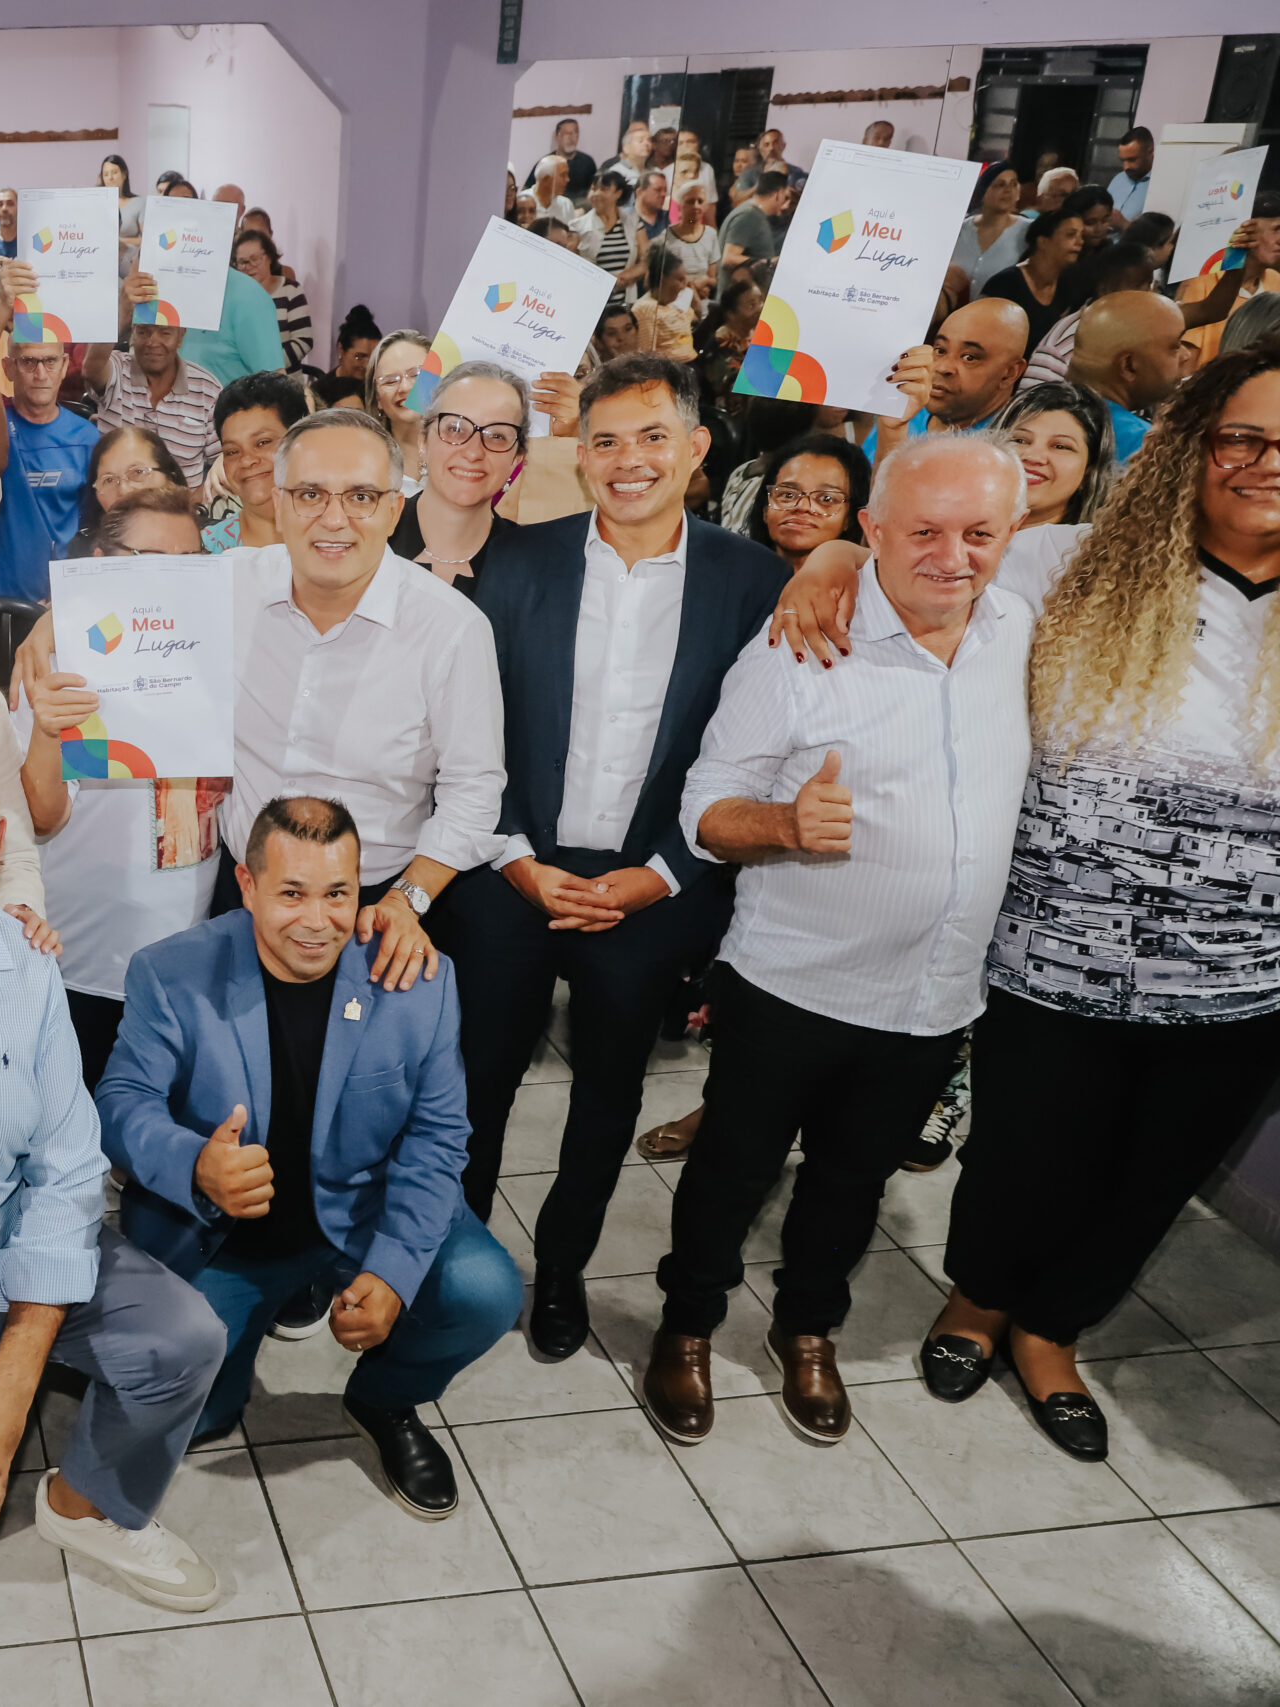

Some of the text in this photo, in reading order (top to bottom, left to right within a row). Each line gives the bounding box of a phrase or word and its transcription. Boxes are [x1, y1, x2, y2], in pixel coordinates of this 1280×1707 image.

[868, 208, 888, 219] Aqui
[58, 231, 84, 240] Meu
[862, 220, 902, 241] Meu
[182, 233, 204, 243] Meu
[60, 242, 100, 258] Lugar
[180, 244, 214, 258] Lugar
[854, 240, 918, 272] Lugar
[529, 286, 546, 297] Aqui
[808, 288, 840, 298] Habitação
[860, 290, 900, 302] São Bernardo
[522, 294, 556, 318] Meu
[867, 298, 888, 306] Campo
[513, 310, 566, 342] Lugar
[132, 606, 154, 616] Aqui
[132, 617, 174, 632] Meu
[134, 634, 200, 658] Lugar
[162, 675, 192, 684] Bernardo
[97, 685, 130, 694] Habitação
